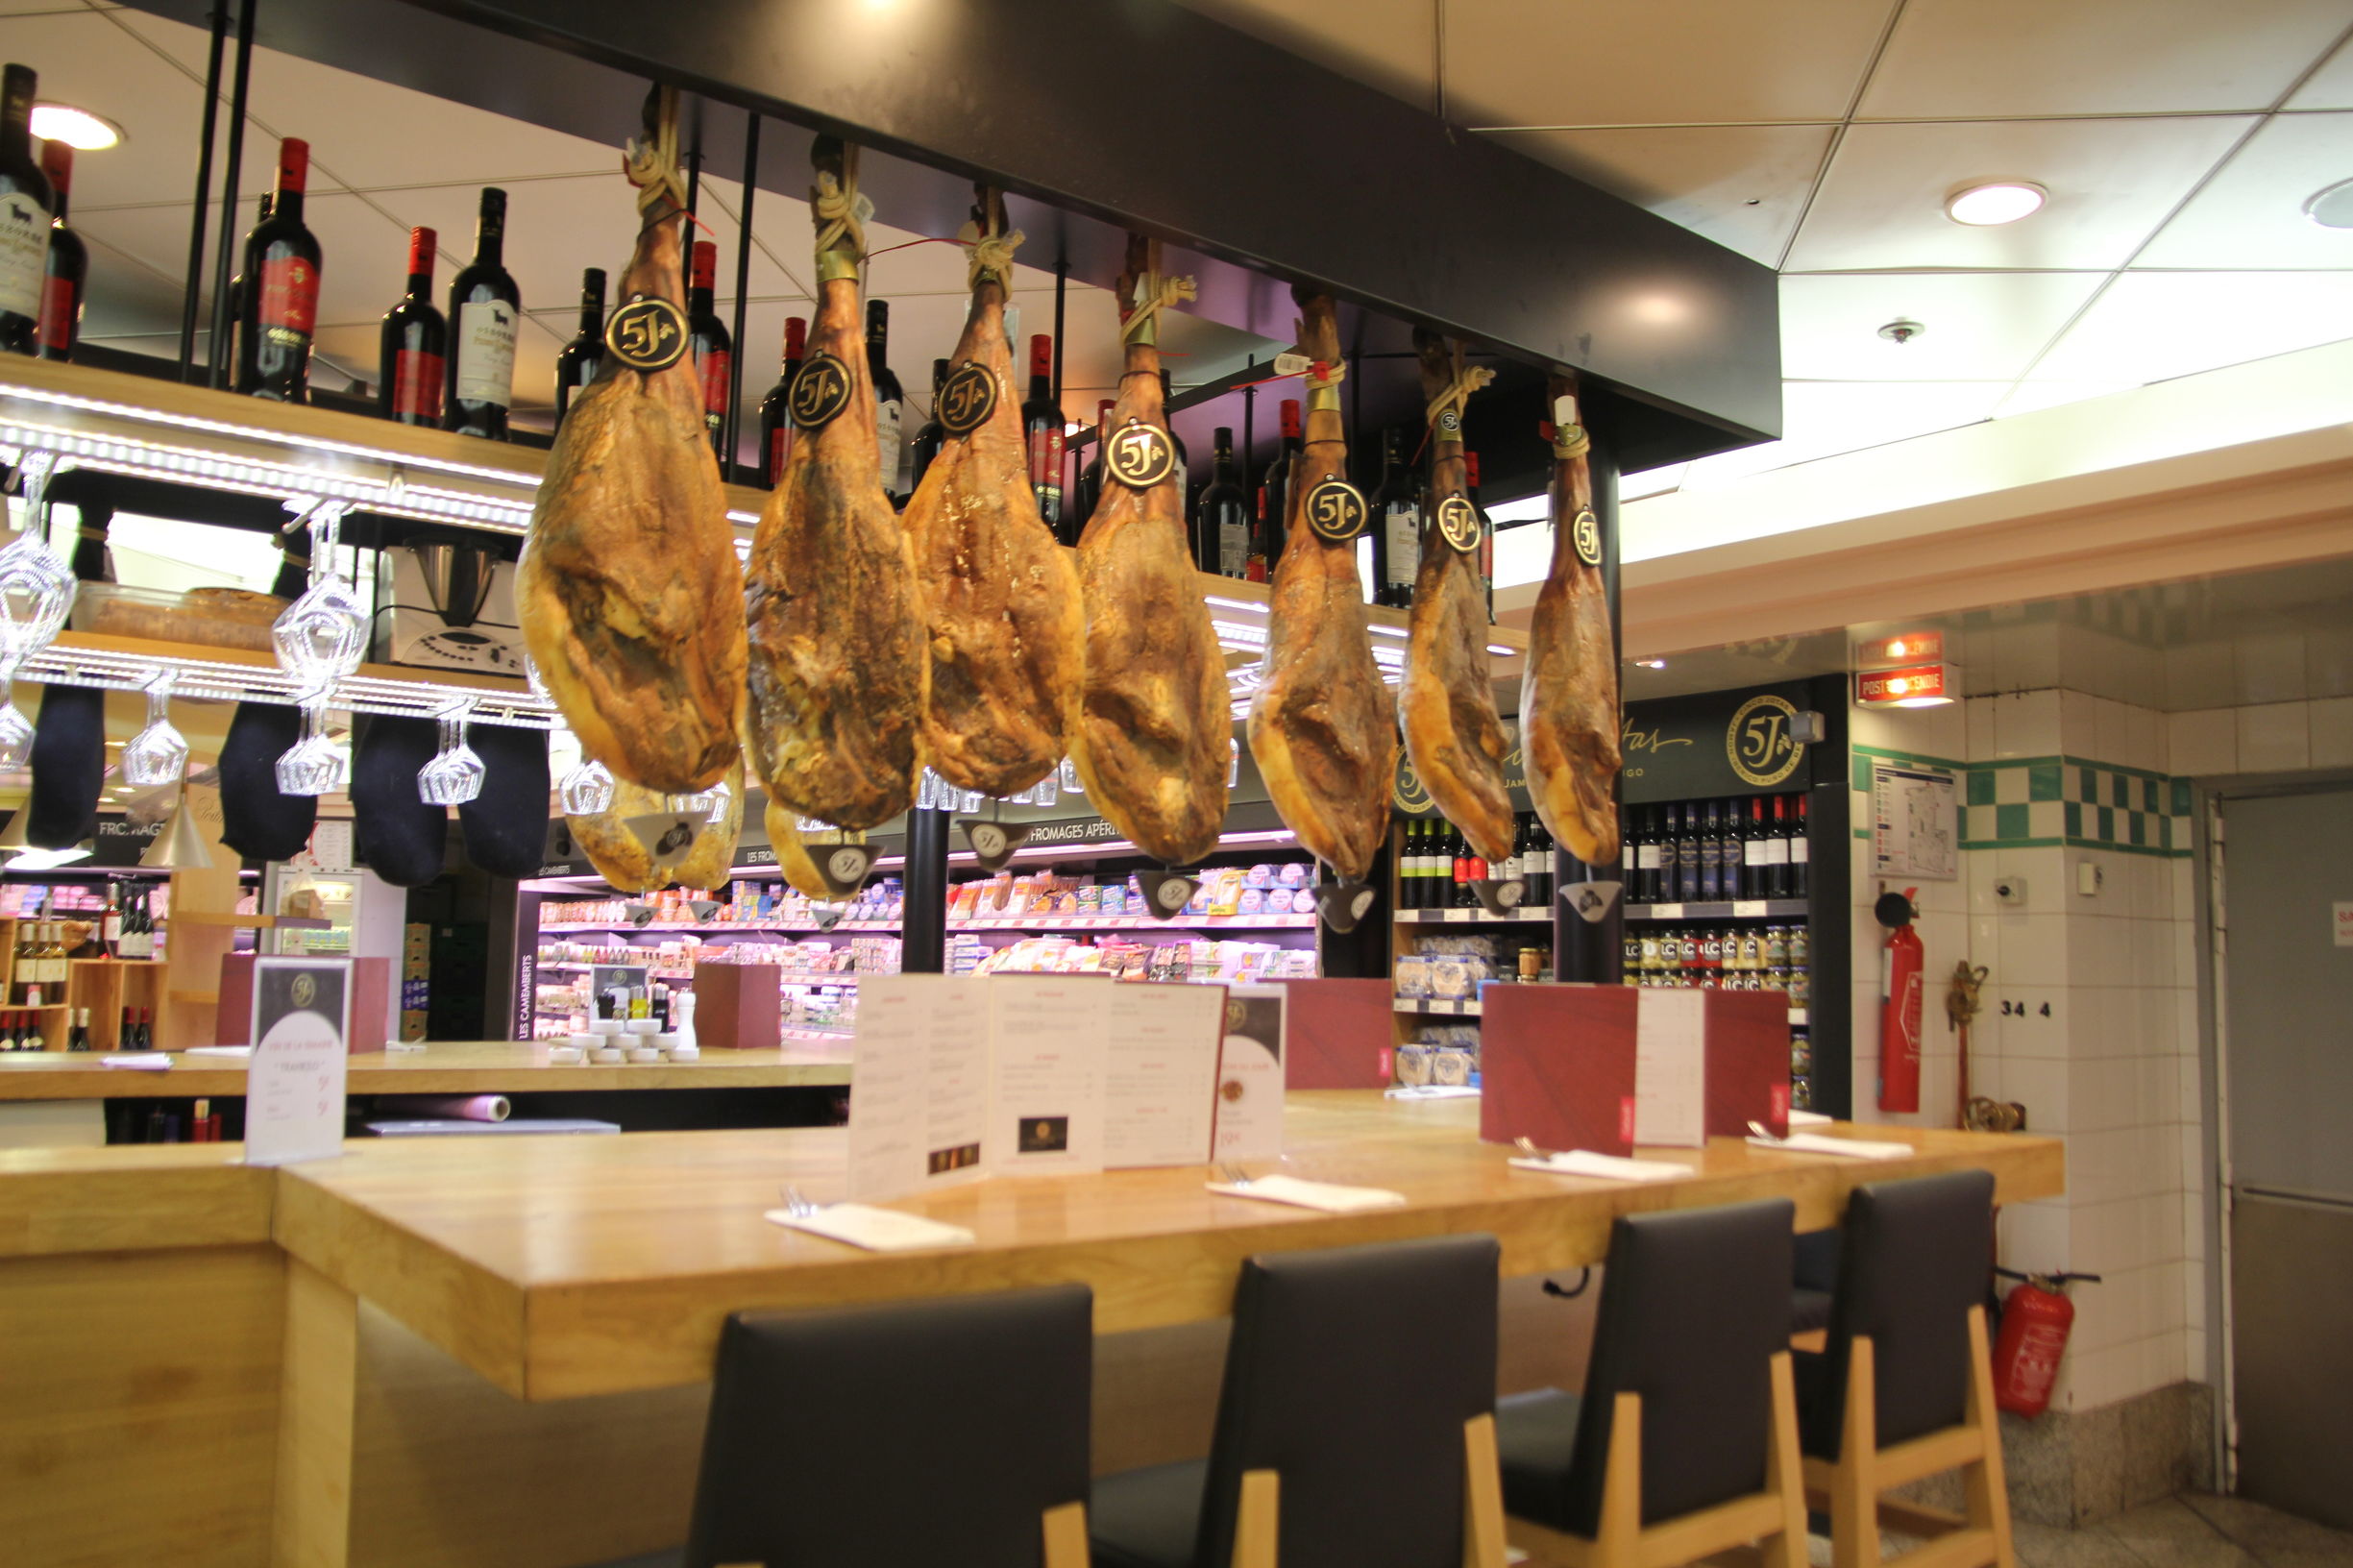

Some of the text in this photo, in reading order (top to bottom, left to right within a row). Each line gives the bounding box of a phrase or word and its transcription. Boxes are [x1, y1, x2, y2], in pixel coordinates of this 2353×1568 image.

[622, 308, 660, 358] 5J
[797, 368, 833, 416] 5J
[946, 376, 977, 422] 5J
[1120, 432, 1153, 477] 5J
[1317, 493, 1348, 530] 5J
[1445, 508, 1470, 543] 5J
[1580, 522, 1596, 556] 5J
[1863, 674, 1941, 695] POST CENDIE
[1743, 714, 1785, 768] 5J
[1661, 943, 1676, 956] LC
[1704, 943, 1720, 955] LC
[1722, 941, 1736, 954] LC
[519, 954, 532, 1040] LES CAMEMBERTS
[2000, 999, 2051, 1017] 34 4
